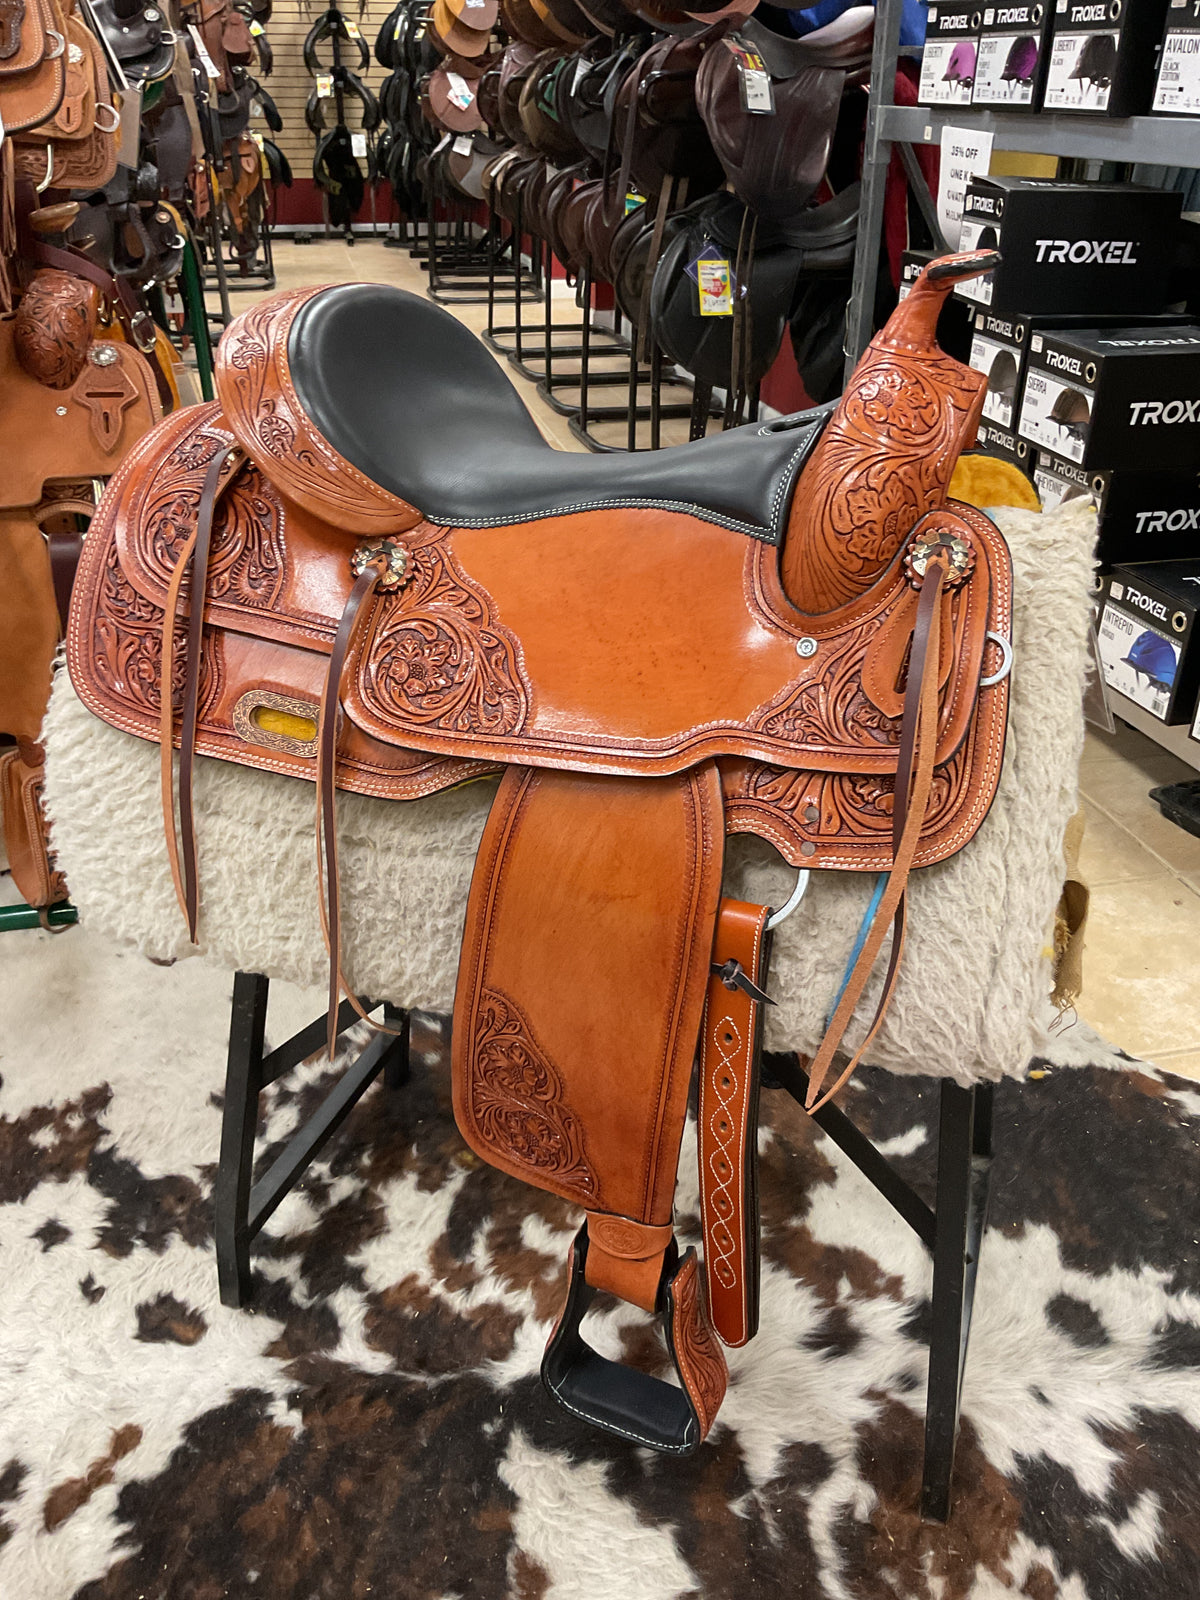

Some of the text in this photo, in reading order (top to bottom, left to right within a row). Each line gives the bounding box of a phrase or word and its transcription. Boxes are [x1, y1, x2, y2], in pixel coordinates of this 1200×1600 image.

[939, 15, 968, 30] TROXEL
[996, 7, 1029, 24] TROXEL
[1070, 4, 1106, 22] TROXEL
[1054, 39, 1076, 52] LIBERTY
[1165, 38, 1200, 54] AVALON
[965, 147, 979, 160] OFF
[950, 168, 963, 181] ONE
[973, 196, 995, 214] TROXEL
[1035, 239, 1137, 264] TROXEL
[987, 316, 1012, 338] TROXEL
[1046, 349, 1082, 376] TROXEL
[1027, 375, 1047, 395] SIERRA
[1129, 400, 1200, 426] TROX
[987, 427, 1015, 451] TROXEL
[1053, 458, 1089, 486] TROXEL
[1135, 508, 1200, 534] TROX
[1126, 586, 1167, 622] TROXEL
[1104, 608, 1134, 636] INTREPID
